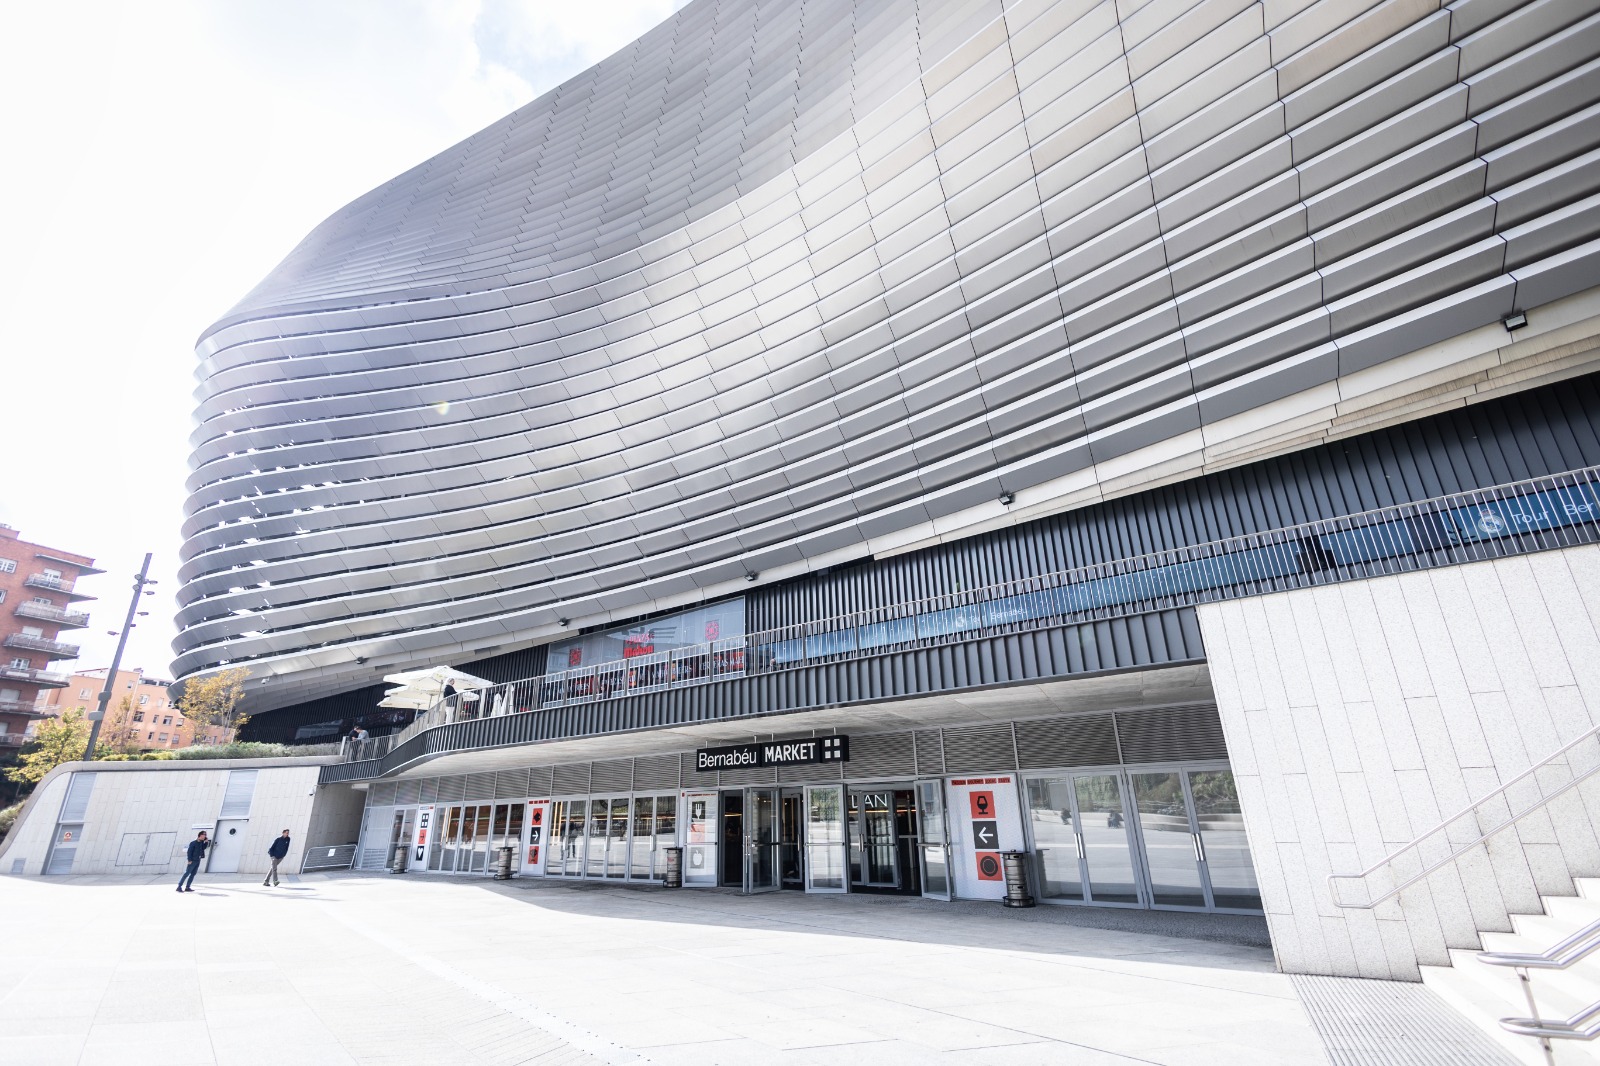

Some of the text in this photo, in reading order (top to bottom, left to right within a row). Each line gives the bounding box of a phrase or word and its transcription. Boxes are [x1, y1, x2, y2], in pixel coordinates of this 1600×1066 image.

[1513, 502, 1600, 524] Tour Ber
[624, 645, 653, 658] Mahou
[698, 742, 816, 768] Bernabéu MARKET
